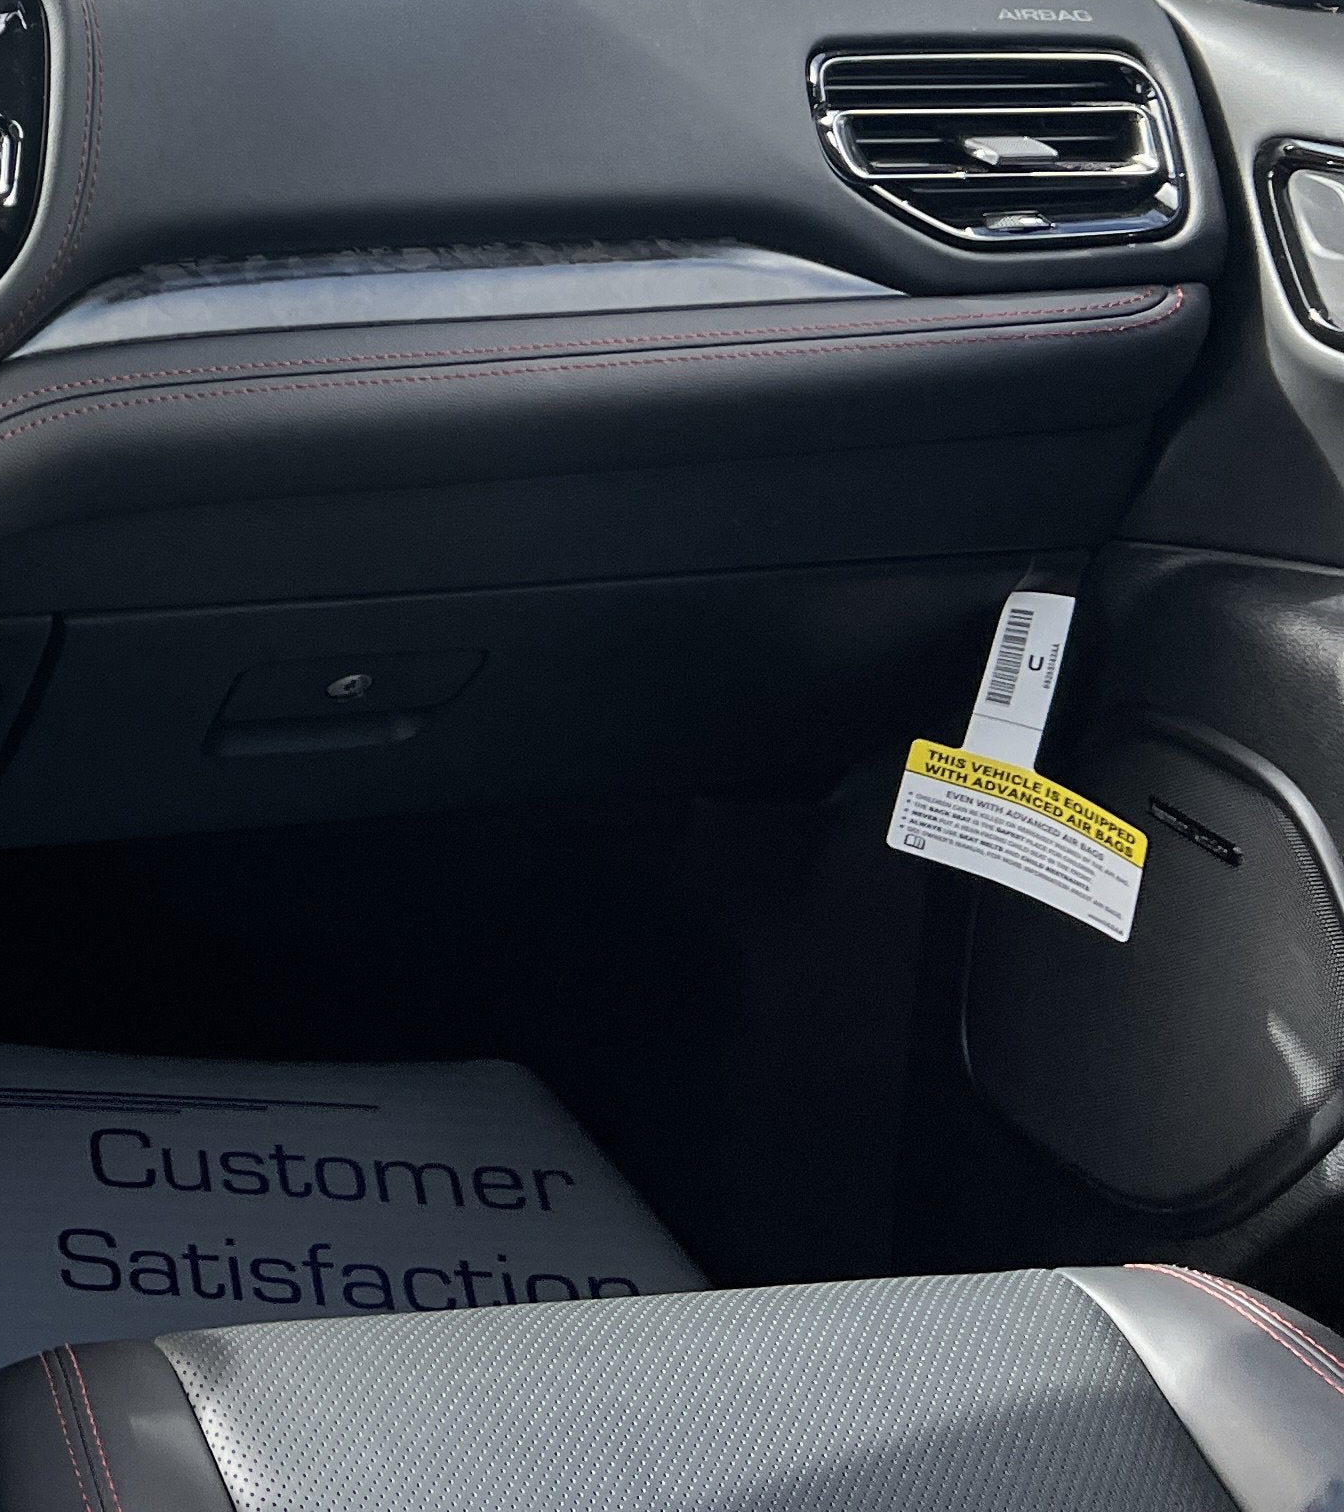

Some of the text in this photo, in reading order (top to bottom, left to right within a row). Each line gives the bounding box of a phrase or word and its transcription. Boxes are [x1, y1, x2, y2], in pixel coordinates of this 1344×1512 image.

[997, 8, 1093, 22] AIRBAG
[1028, 654, 1044, 671] U
[924, 762, 1134, 858] WITH ADVANCED AIR BAGS
[929, 749, 1136, 845] THIS VEHICLE IS EQUIPPED
[946, 790, 974, 804] EVEN
[976, 799, 1004, 814] WITH
[1006, 809, 1060, 838] ADVANCED
[1062, 833, 1078, 846] AIR
[1080, 842, 1104, 861] BAGS
[88, 1128, 575, 1212] Customer
[57, 1227, 641, 1312] Satisfaction
